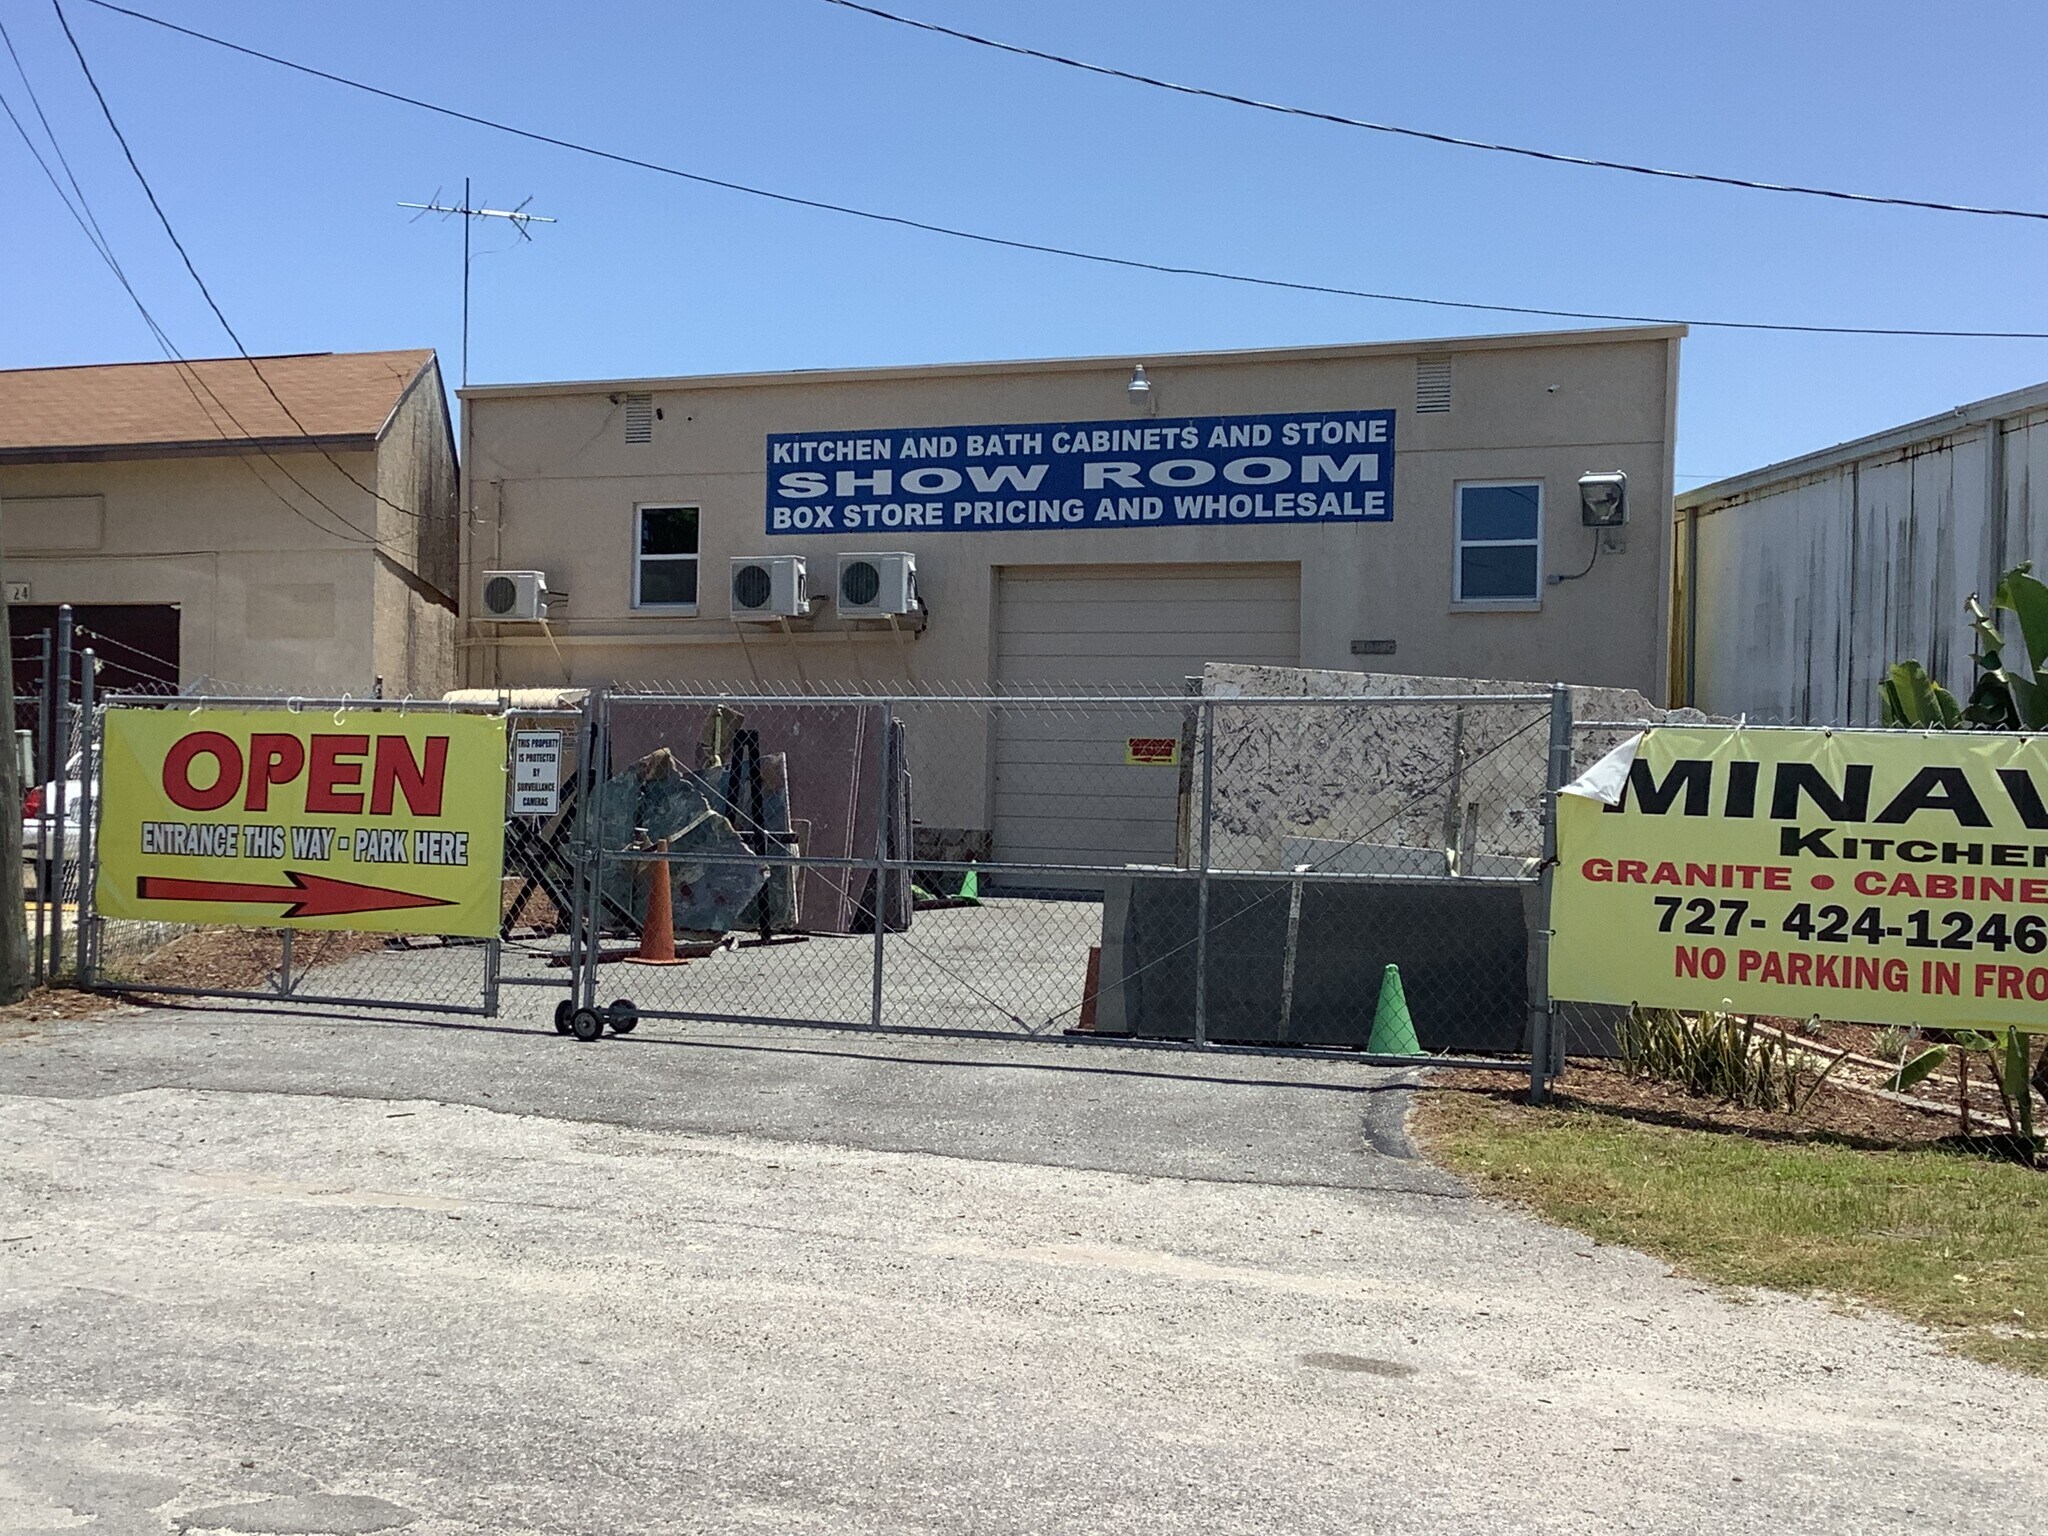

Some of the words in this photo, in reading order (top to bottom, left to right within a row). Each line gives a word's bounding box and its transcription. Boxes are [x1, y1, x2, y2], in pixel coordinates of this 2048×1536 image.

[773, 438, 892, 463] KITCHEN
[899, 437, 957, 459] AND
[966, 433, 1043, 457] BATH
[1051, 426, 1200, 454] CABINETS
[1207, 424, 1272, 448] AND
[1281, 419, 1388, 445] STONE
[776, 464, 1050, 499] SHOW
[1083, 453, 1379, 490] ROOM
[772, 505, 834, 529] BOX
[842, 502, 943, 527] STORE
[953, 498, 1085, 525] PRICING
[1094, 496, 1164, 521] AND
[1174, 491, 1386, 519] WHOLESALE
[518, 739, 530, 748] THIS
[531, 739, 558, 748] PROPERTY
[518, 753, 525, 762] IS
[526, 753, 556, 762] PROTECTED
[161, 730, 450, 817] OPEN
[517, 782, 555, 792] SURVEILLANCE
[532, 768, 540, 777] BY
[523, 797, 548, 806] CAMERAS
[141, 822, 238, 857] ENTRANCE
[243, 825, 286, 859] THIS
[291, 828, 335, 861] WAY
[353, 831, 408, 864] PARK
[413, 833, 469, 867] HERE
[1581, 858, 1793, 892] GRANITE
[1854, 871, 2048, 905] CABINE
[1675, 946, 1726, 981] NO
[1738, 950, 1908, 994] PARKING
[1921, 961, 1961, 997] IN
[1974, 963, 2048, 1001] FRO
